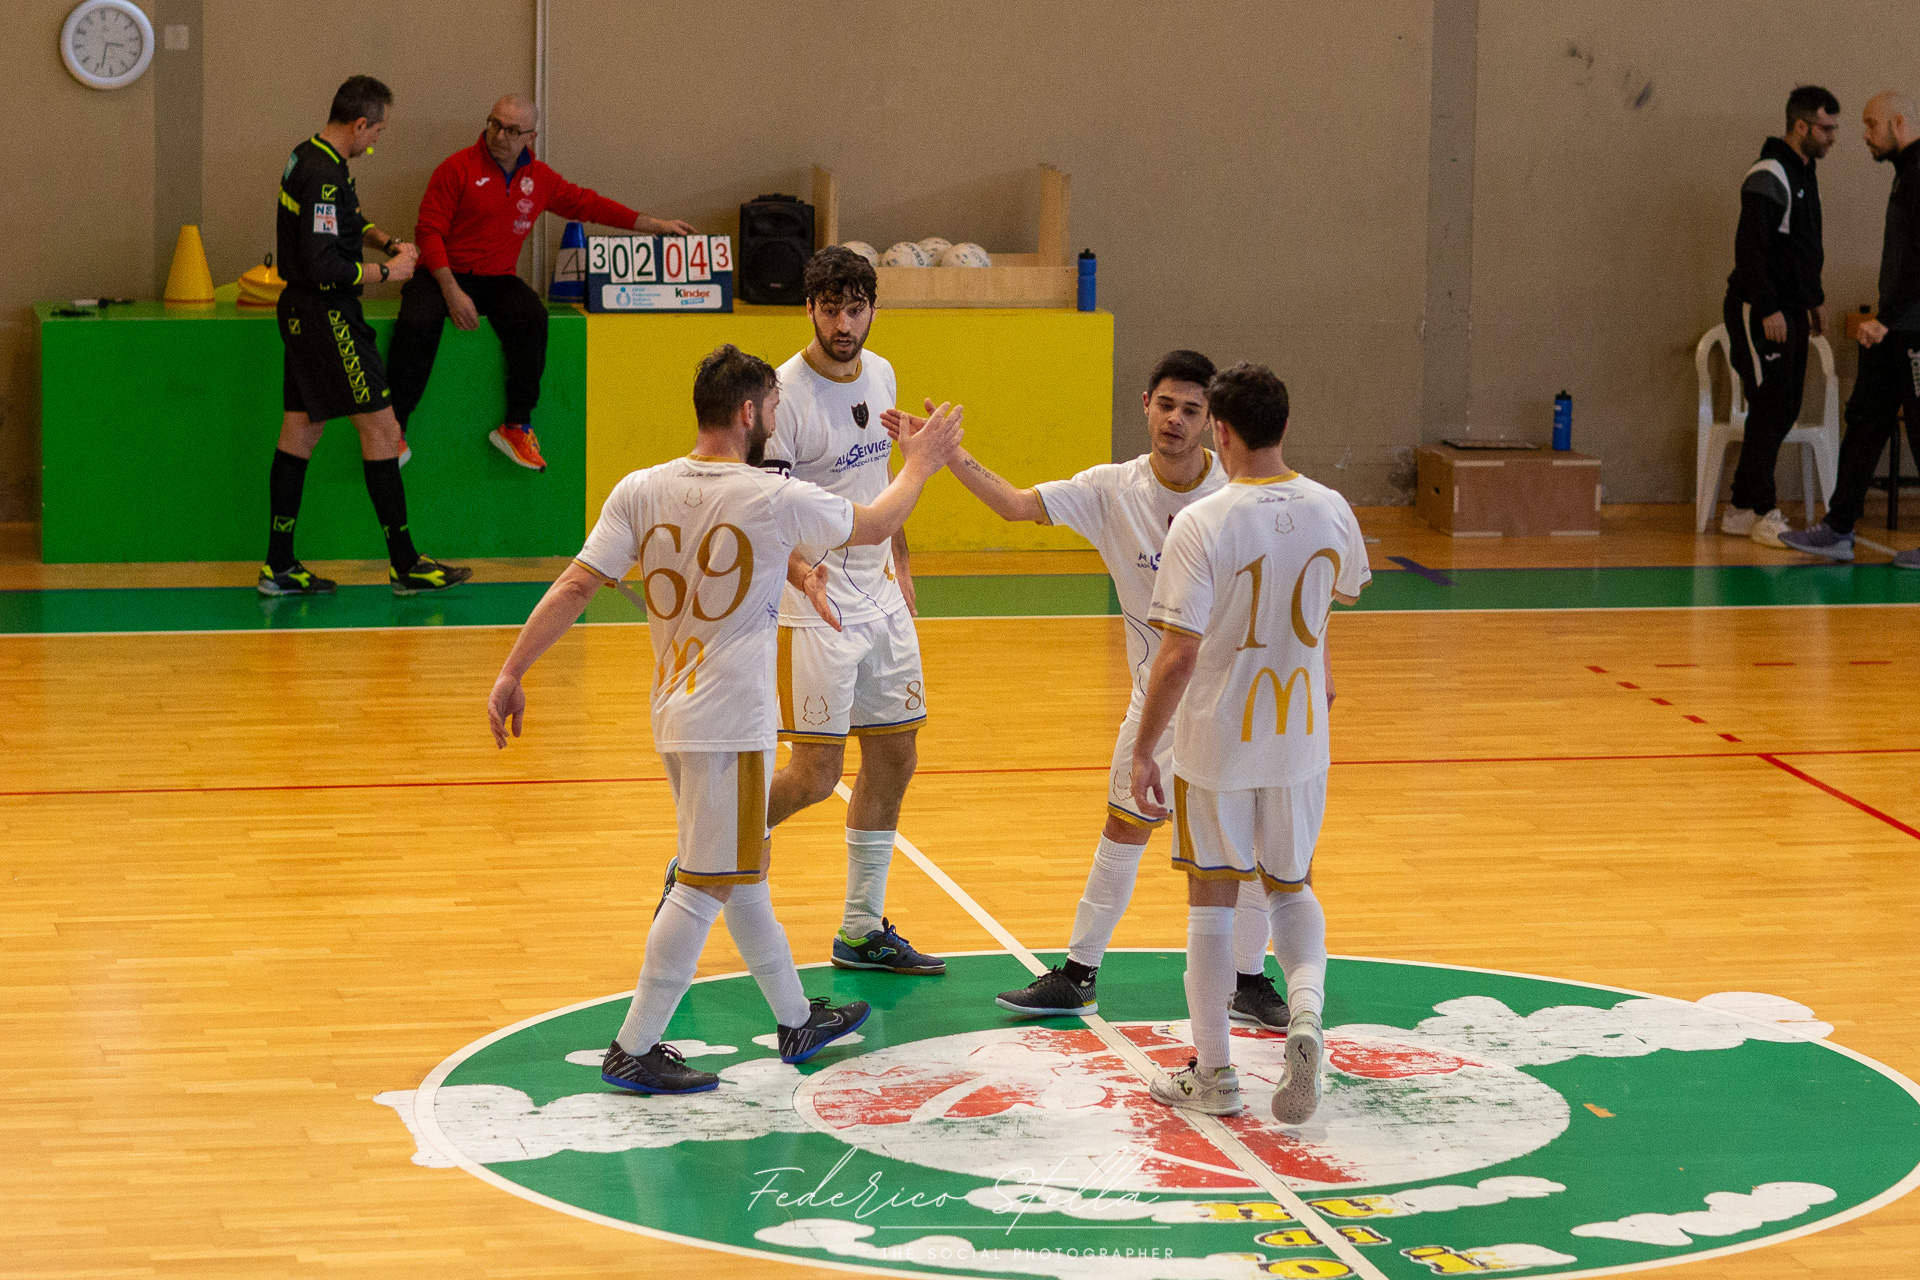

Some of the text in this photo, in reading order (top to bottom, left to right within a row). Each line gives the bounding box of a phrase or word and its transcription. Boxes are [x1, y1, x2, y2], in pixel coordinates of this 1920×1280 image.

[562, 250, 586, 279] 4
[640, 523, 754, 622] 69
[1235, 547, 1342, 652] 10
[904, 680, 926, 711] 8
